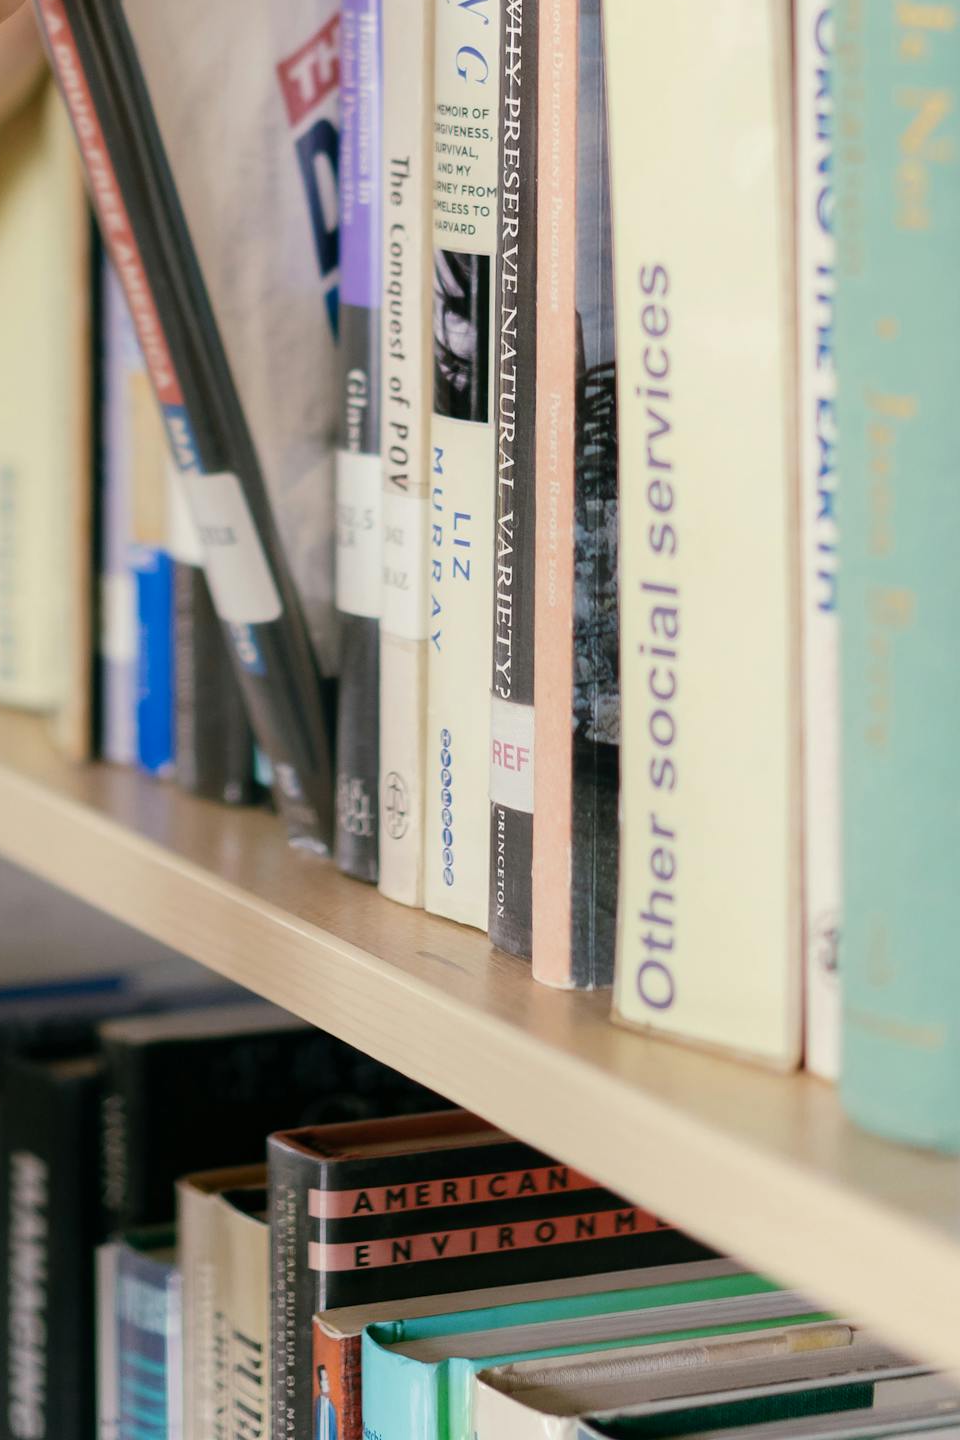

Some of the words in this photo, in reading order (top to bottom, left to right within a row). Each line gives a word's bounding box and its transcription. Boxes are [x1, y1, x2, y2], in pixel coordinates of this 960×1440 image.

[433, 121, 494, 142] RGIVENESS,
[472, 107, 490, 120] OF
[389, 156, 410, 207] The
[437, 162, 454, 175] AND
[456, 164, 472, 177] MY
[461, 184, 497, 198] FROM
[501, 95, 522, 294] PRESERVE
[52, 43, 125, 234] DRUG-FREE
[112, 240, 172, 390] AMERICA
[473, 205, 490, 217] TO
[387, 222, 407, 361] Conquest
[388, 375, 410, 410] of
[498, 306, 518, 497] NATURAL
[635, 262, 677, 558] services
[388, 421, 410, 493] POV
[431, 446, 444, 652] MURRAY
[452, 511, 472, 582] LIZ
[495, 510, 515, 699] VARIETY?
[639, 581, 681, 792] social
[492, 739, 530, 772] REF
[496, 809, 506, 919] PRINCETON
[635, 813, 678, 1013] Other
[352, 1166, 570, 1215] AMERICAN
